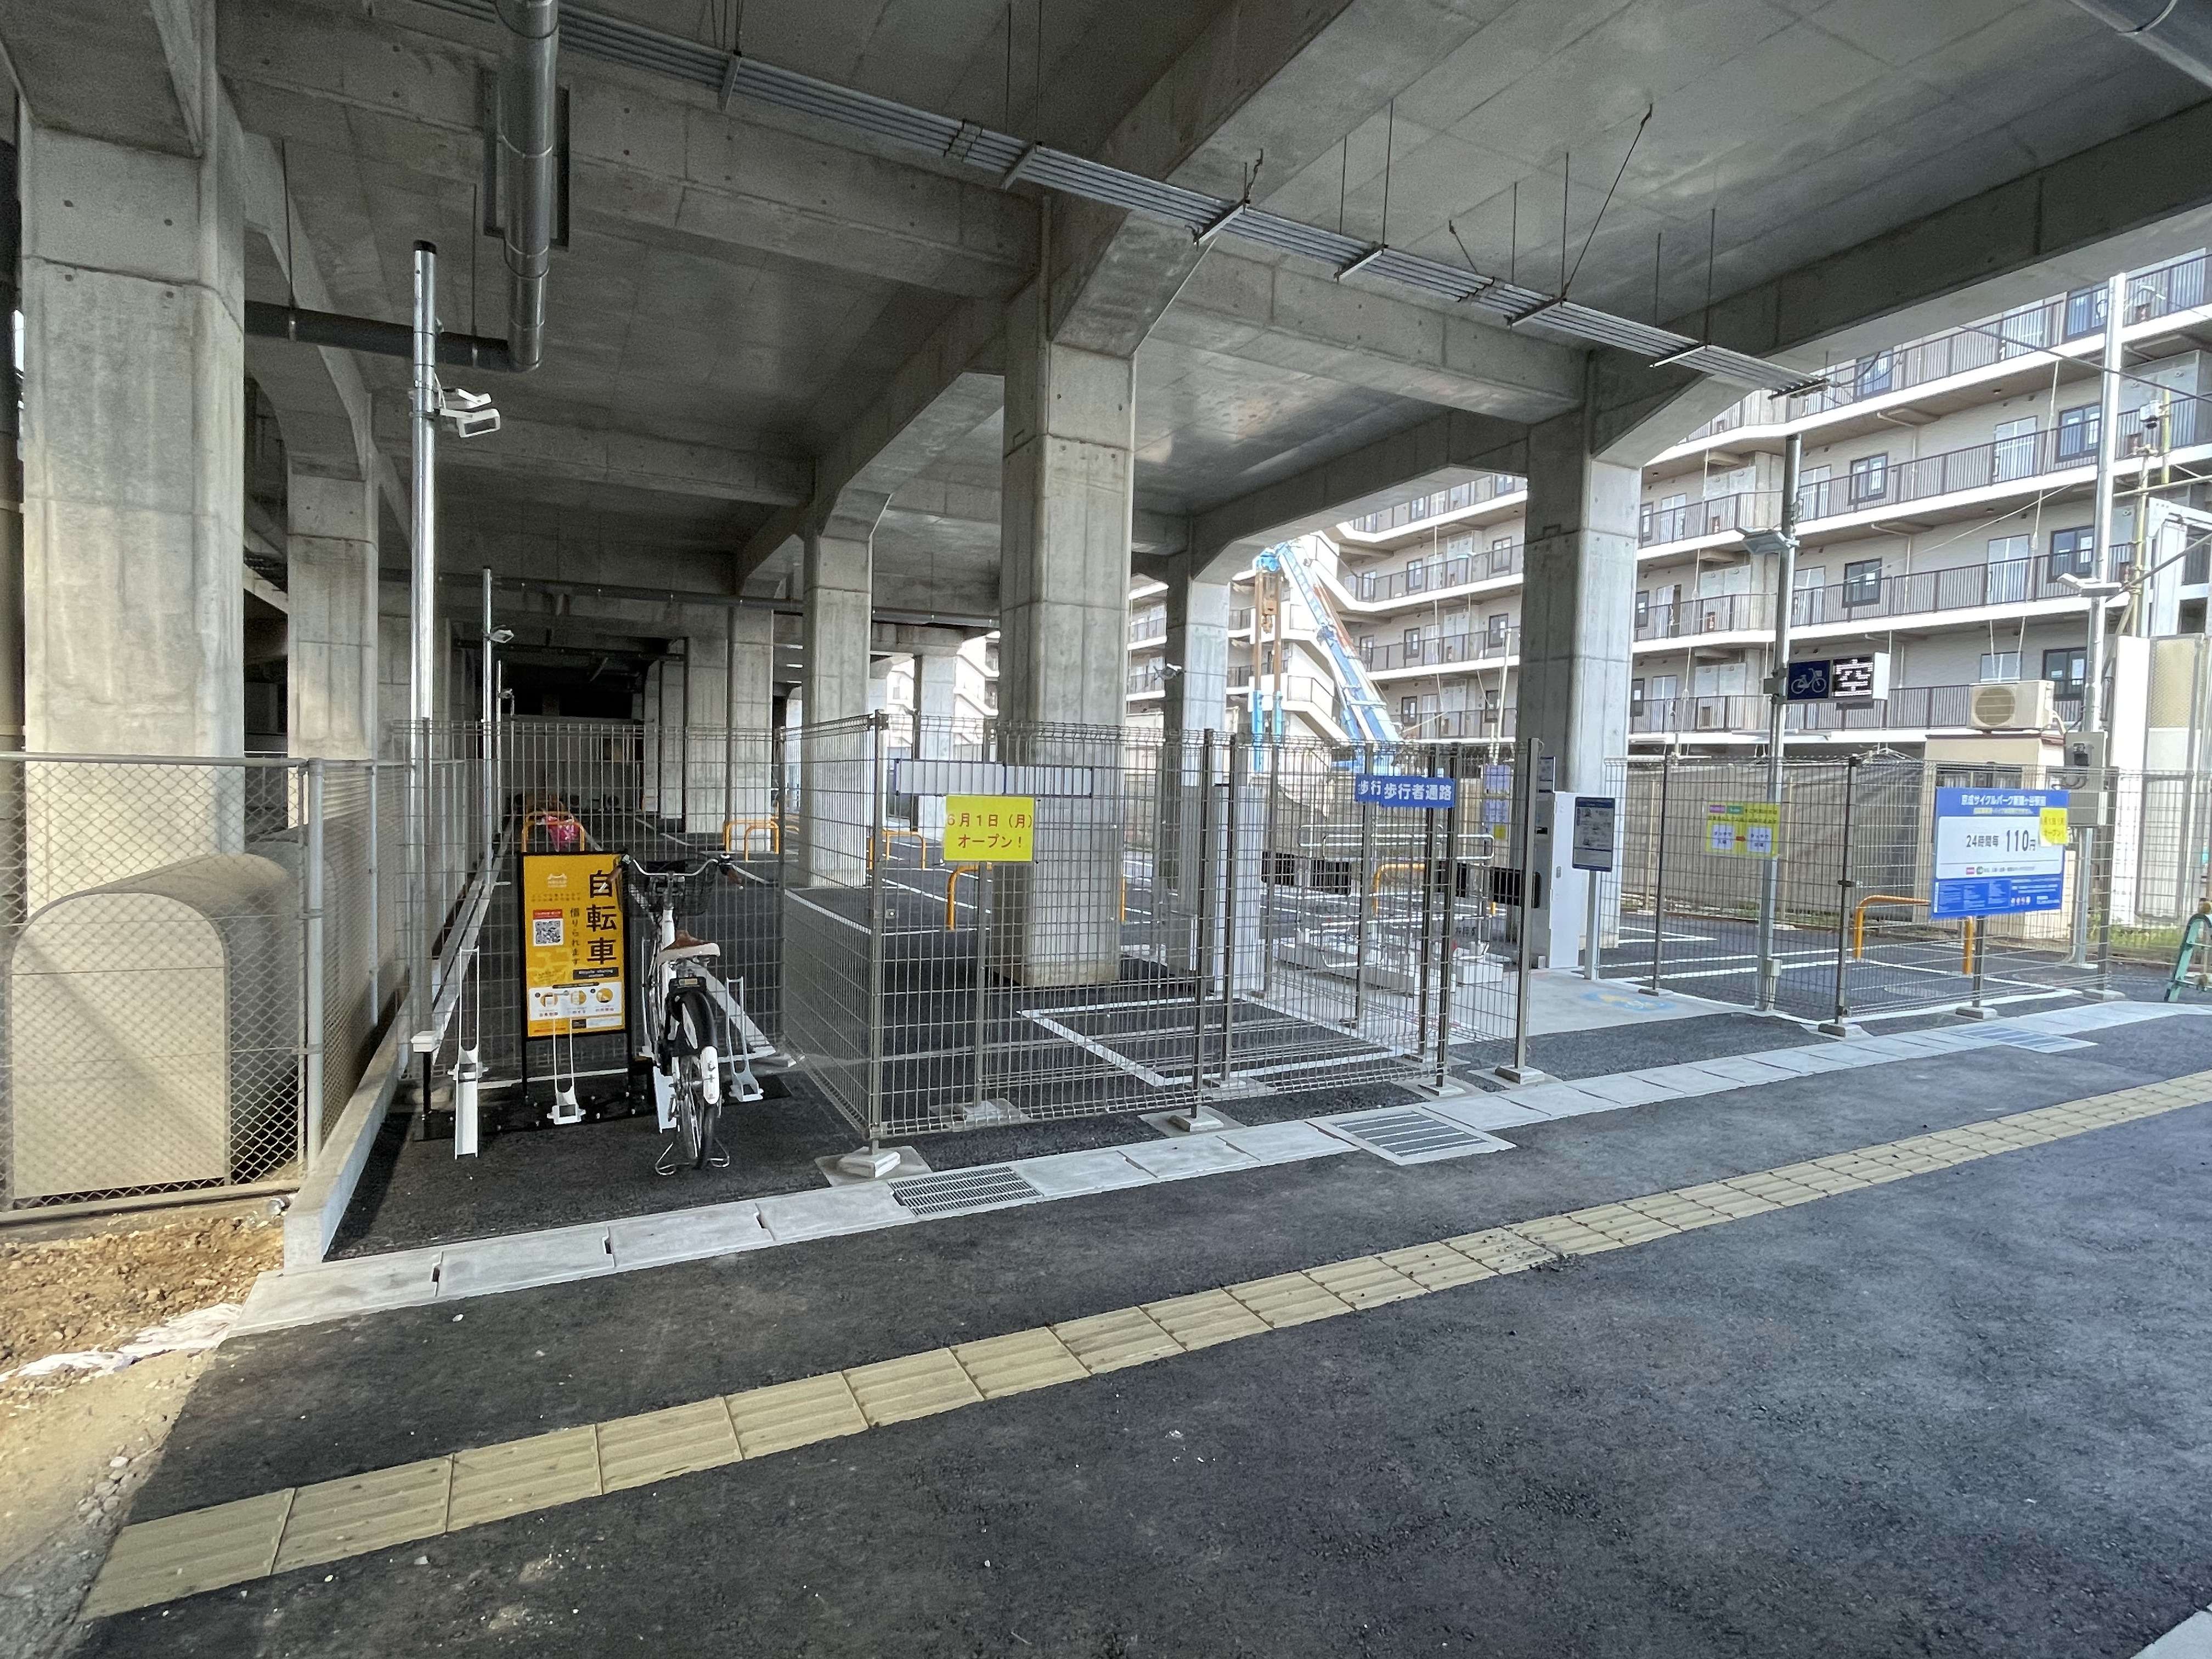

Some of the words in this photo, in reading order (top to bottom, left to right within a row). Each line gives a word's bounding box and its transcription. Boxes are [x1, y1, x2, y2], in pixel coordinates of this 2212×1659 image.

[1384, 783, 1452, 800] 歩行者通路
[2006, 830, 2036, 852] 110円
[570, 907, 580, 966] 借りられます
[586, 870, 617, 965] 自転車
